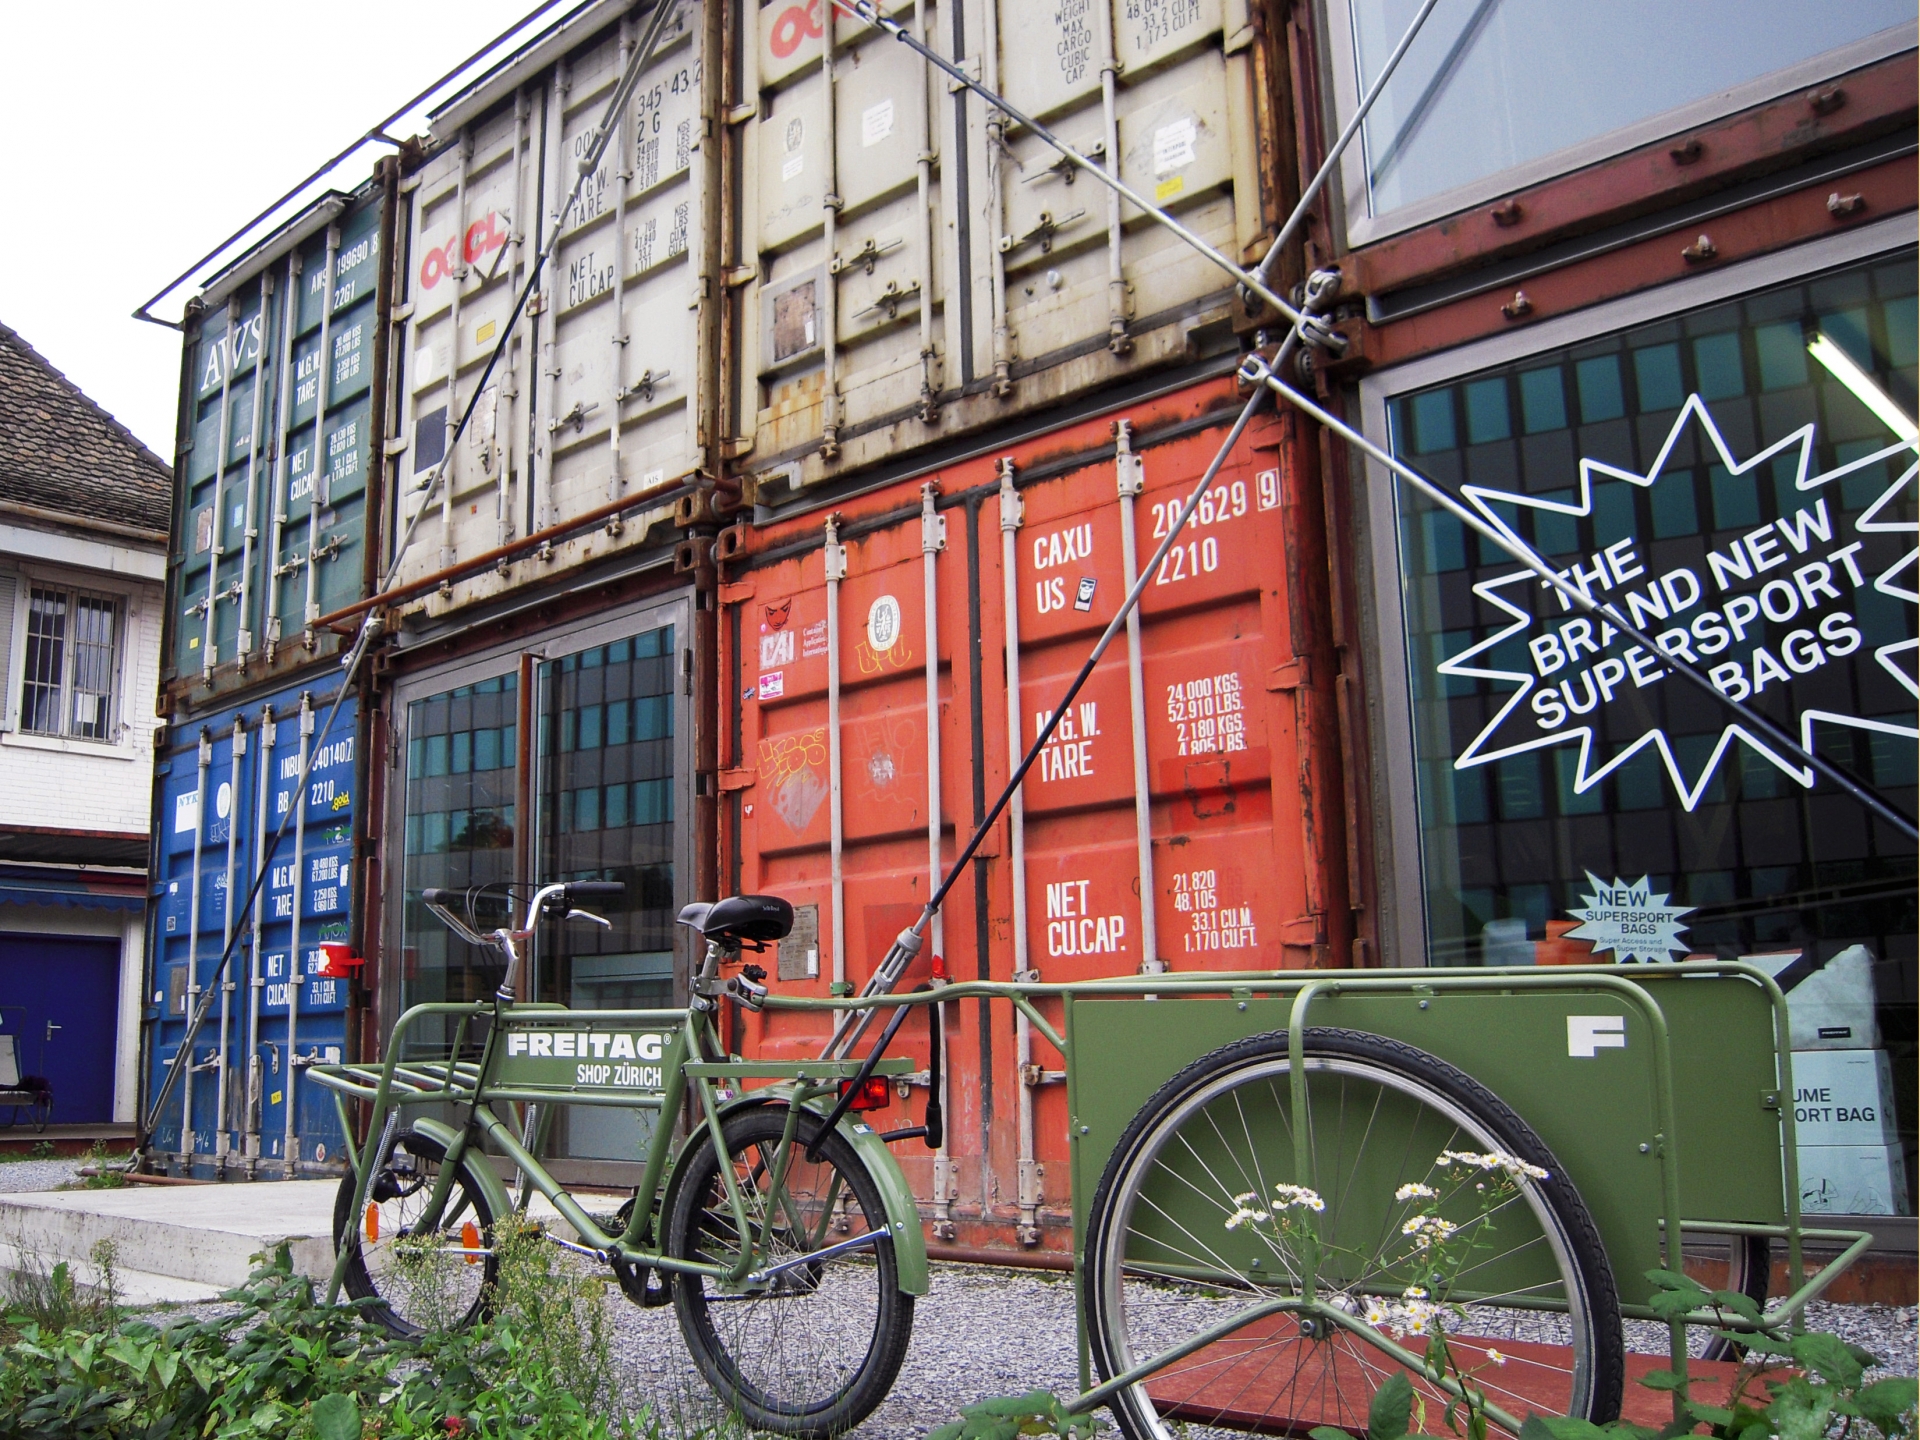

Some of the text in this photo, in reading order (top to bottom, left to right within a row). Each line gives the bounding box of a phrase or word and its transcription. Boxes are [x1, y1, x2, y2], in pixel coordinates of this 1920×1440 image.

[1055, 0, 1090, 26] WEIGHT
[1062, 18, 1084, 39] MAX
[1057, 30, 1092, 56] CARGO
[1060, 47, 1091, 71] CUBIC
[336, 240, 368, 277] 199690
[334, 279, 356, 310] 22G1
[201, 312, 262, 392] AWS
[296, 378, 317, 406] TARE
[292, 448, 309, 475] NET
[290, 470, 314, 502] CU.CA
[1033, 523, 1092, 570] CAXU
[1036, 537, 1219, 614] US 2210
[1528, 498, 1833, 678] BRAND NEW
[1540, 537, 1645, 612] THE
[1531, 540, 1865, 730] SUPERSPORT
[1708, 611, 1863, 703] BAGS
[1166, 677, 1213, 705] 24.000
[1213, 671, 1243, 696] KGS.
[1167, 691, 1245, 723] 52.910 LBS.
[1038, 712, 1247, 783] TARE 2.180 KGS.
[281, 753, 301, 781] INBU
[277, 790, 290, 814] BB
[311, 780, 335, 806] 2210
[272, 893, 293, 917] ARE
[1046, 879, 1091, 919] NET
[1173, 869, 1216, 893] 21.820
[1174, 888, 1217, 912] 48.105
[1599, 889, 1648, 907] NEW
[1585, 910, 1674, 924] SUPERSPORT
[1621, 923, 1657, 935] BAGS
[1047, 914, 1127, 957] CU.CAP.
[1191, 910, 1217, 932] 33.1
[1183, 930, 1219, 953] 1.170
[1599, 937, 1619, 946] Super
[1621, 937, 1647, 945] Access
[1616, 945, 1637, 954] Super
[267, 954, 285, 977] NET
[1566, 1016, 1626, 1058] F
[577, 1061, 663, 1087] SHOP ZÜRICH
[1836, 1107, 1875, 1122] BAG
